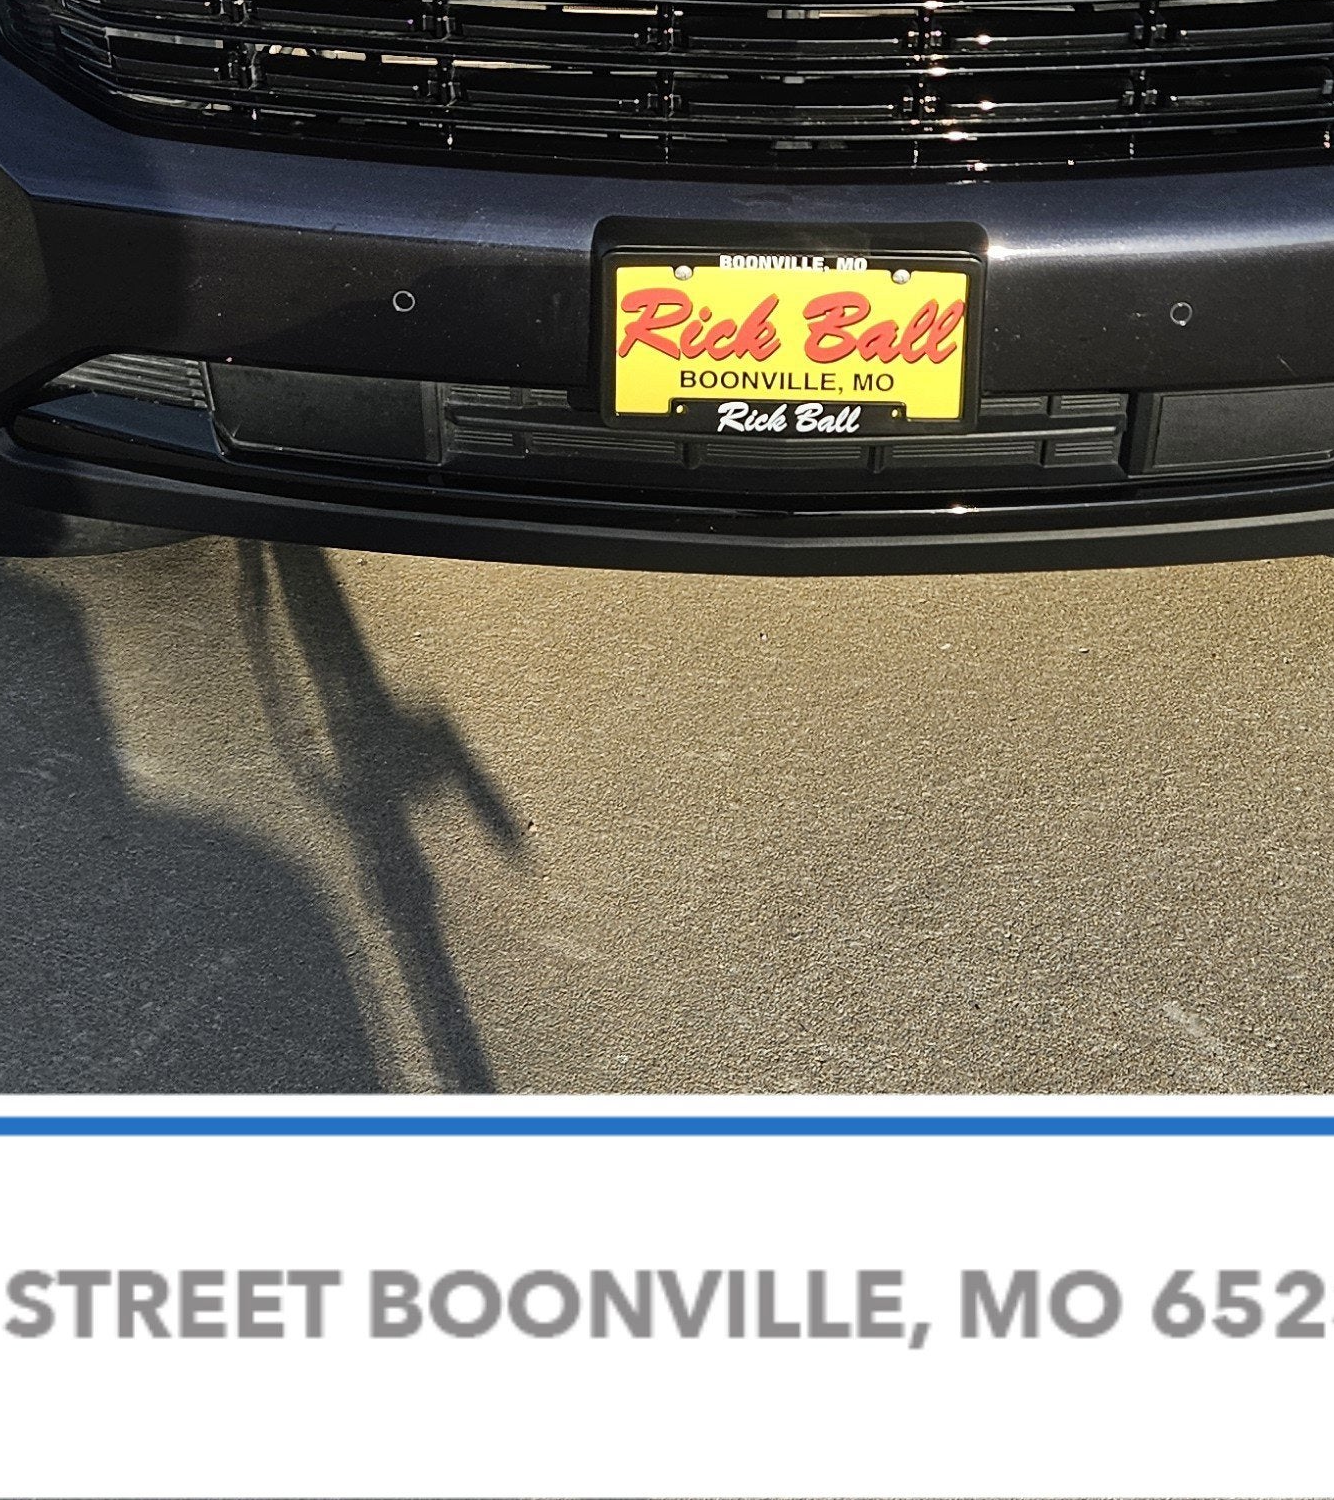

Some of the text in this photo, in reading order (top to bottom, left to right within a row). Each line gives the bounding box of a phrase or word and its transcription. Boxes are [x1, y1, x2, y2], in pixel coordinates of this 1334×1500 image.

[719, 254, 867, 273] BOONVILLE, MO
[616, 287, 966, 364] Rick Ball
[680, 370, 895, 395] BOONVILLE, MO
[717, 401, 863, 433] Rick Ball
